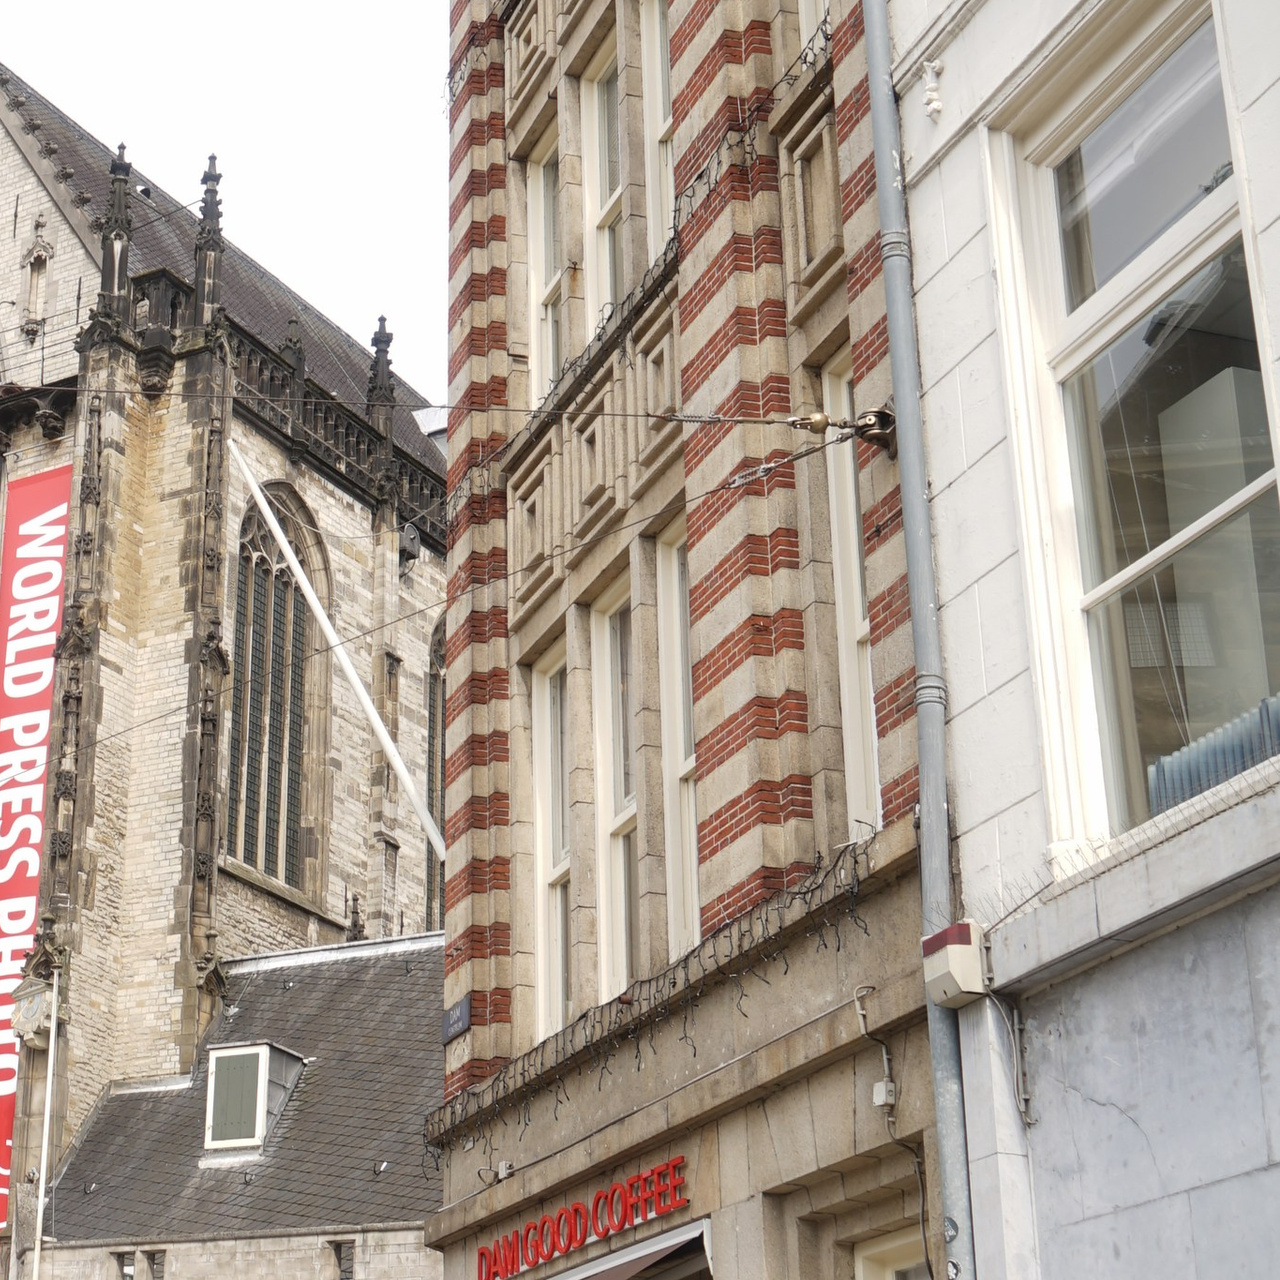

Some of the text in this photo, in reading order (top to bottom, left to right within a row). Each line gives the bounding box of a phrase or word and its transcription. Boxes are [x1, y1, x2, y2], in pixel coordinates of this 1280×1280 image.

[3, 501, 69, 699] WORLD
[522, 1201, 589, 1268] GOOD
[591, 1155, 689, 1239] COFFEE
